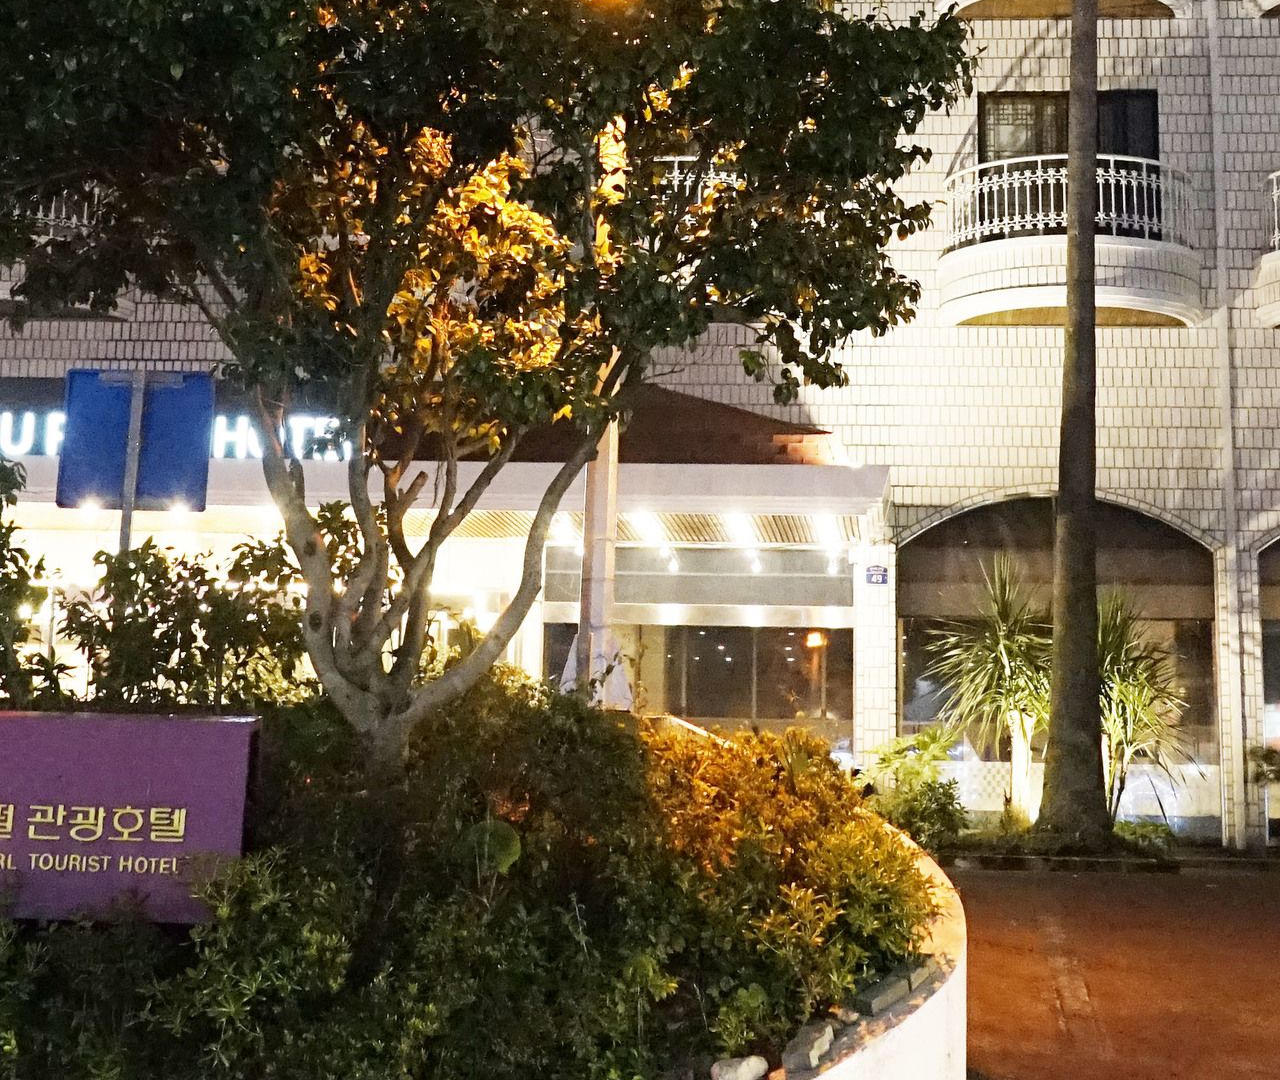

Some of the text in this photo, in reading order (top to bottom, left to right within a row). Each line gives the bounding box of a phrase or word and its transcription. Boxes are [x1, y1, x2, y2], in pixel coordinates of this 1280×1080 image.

[870, 573, 883, 584] 49
[26, 804, 187, 843] 관광호텔
[28, 853, 113, 873] TOURIST
[118, 855, 180, 874] HOTEL
